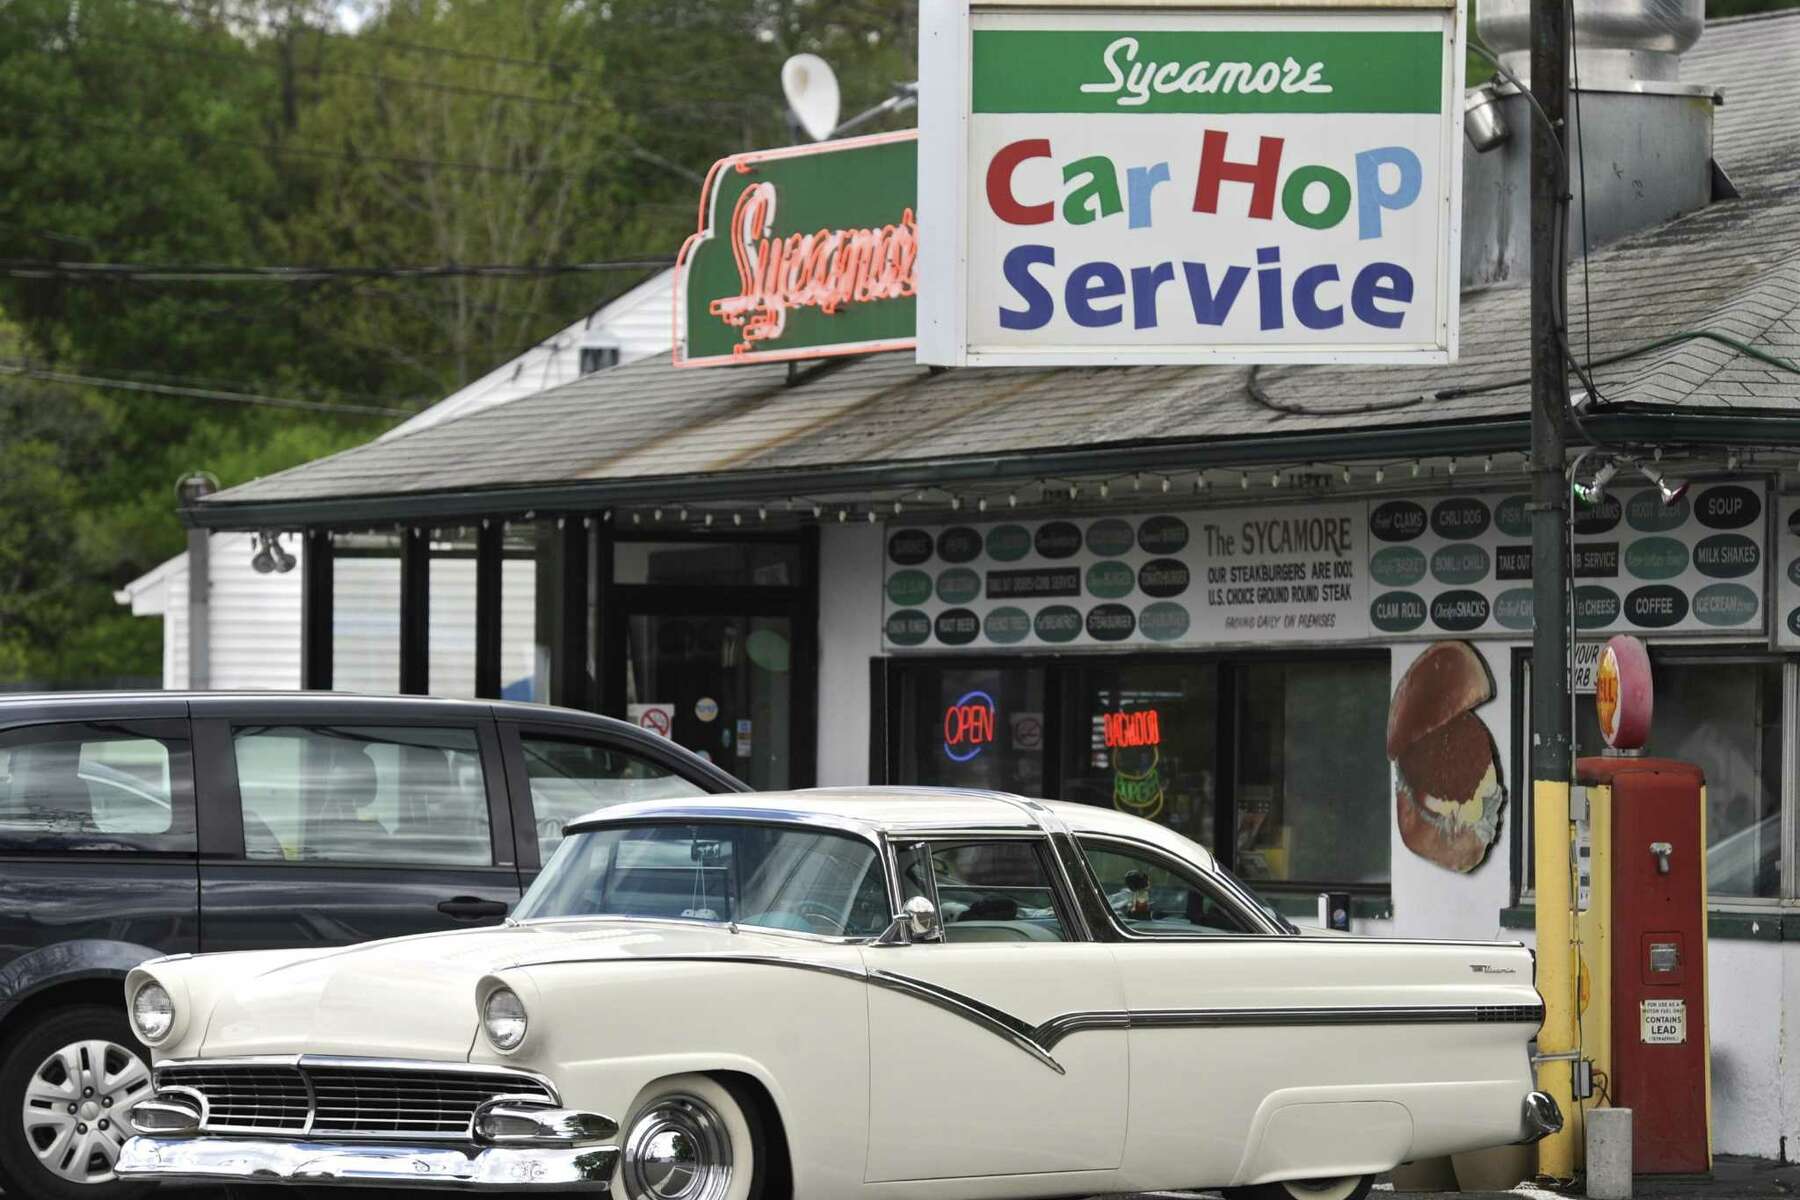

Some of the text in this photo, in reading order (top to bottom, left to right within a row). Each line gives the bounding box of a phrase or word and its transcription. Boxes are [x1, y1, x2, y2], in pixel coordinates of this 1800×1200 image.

[1080, 37, 1334, 106] Sycamore
[986, 129, 1423, 241] Car Hop
[999, 244, 1414, 331] Service
[1708, 497, 1743, 516] SOUP
[1394, 512, 1424, 529] CLAMS
[1463, 509, 1482, 526] DOG
[1203, 524, 1236, 557] The
[1242, 517, 1353, 557] SYCAMORE
[1499, 555, 1530, 571] TAKE OUT
[1584, 552, 1616, 568] SERVICE
[1698, 547, 1719, 564] MILK
[1721, 545, 1756, 563] SHAKES
[1208, 566, 1227, 584] OUR
[1230, 562, 1306, 583] STEAKBURGERS
[1311, 561, 1331, 580] ARE
[1208, 584, 1352, 606] U.S. CHOICE GROUND ROUND STEAK
[1376, 602, 1422, 619] CLAM ROLL
[1457, 601, 1485, 617] SNACKS
[1585, 599, 1616, 615] CHEESE
[1635, 598, 1673, 614] COFFEE
[944, 704, 995, 745] OPEN
[1645, 1016, 1682, 1024] CONTAINS
[1651, 1026, 1677, 1034] LEAD
